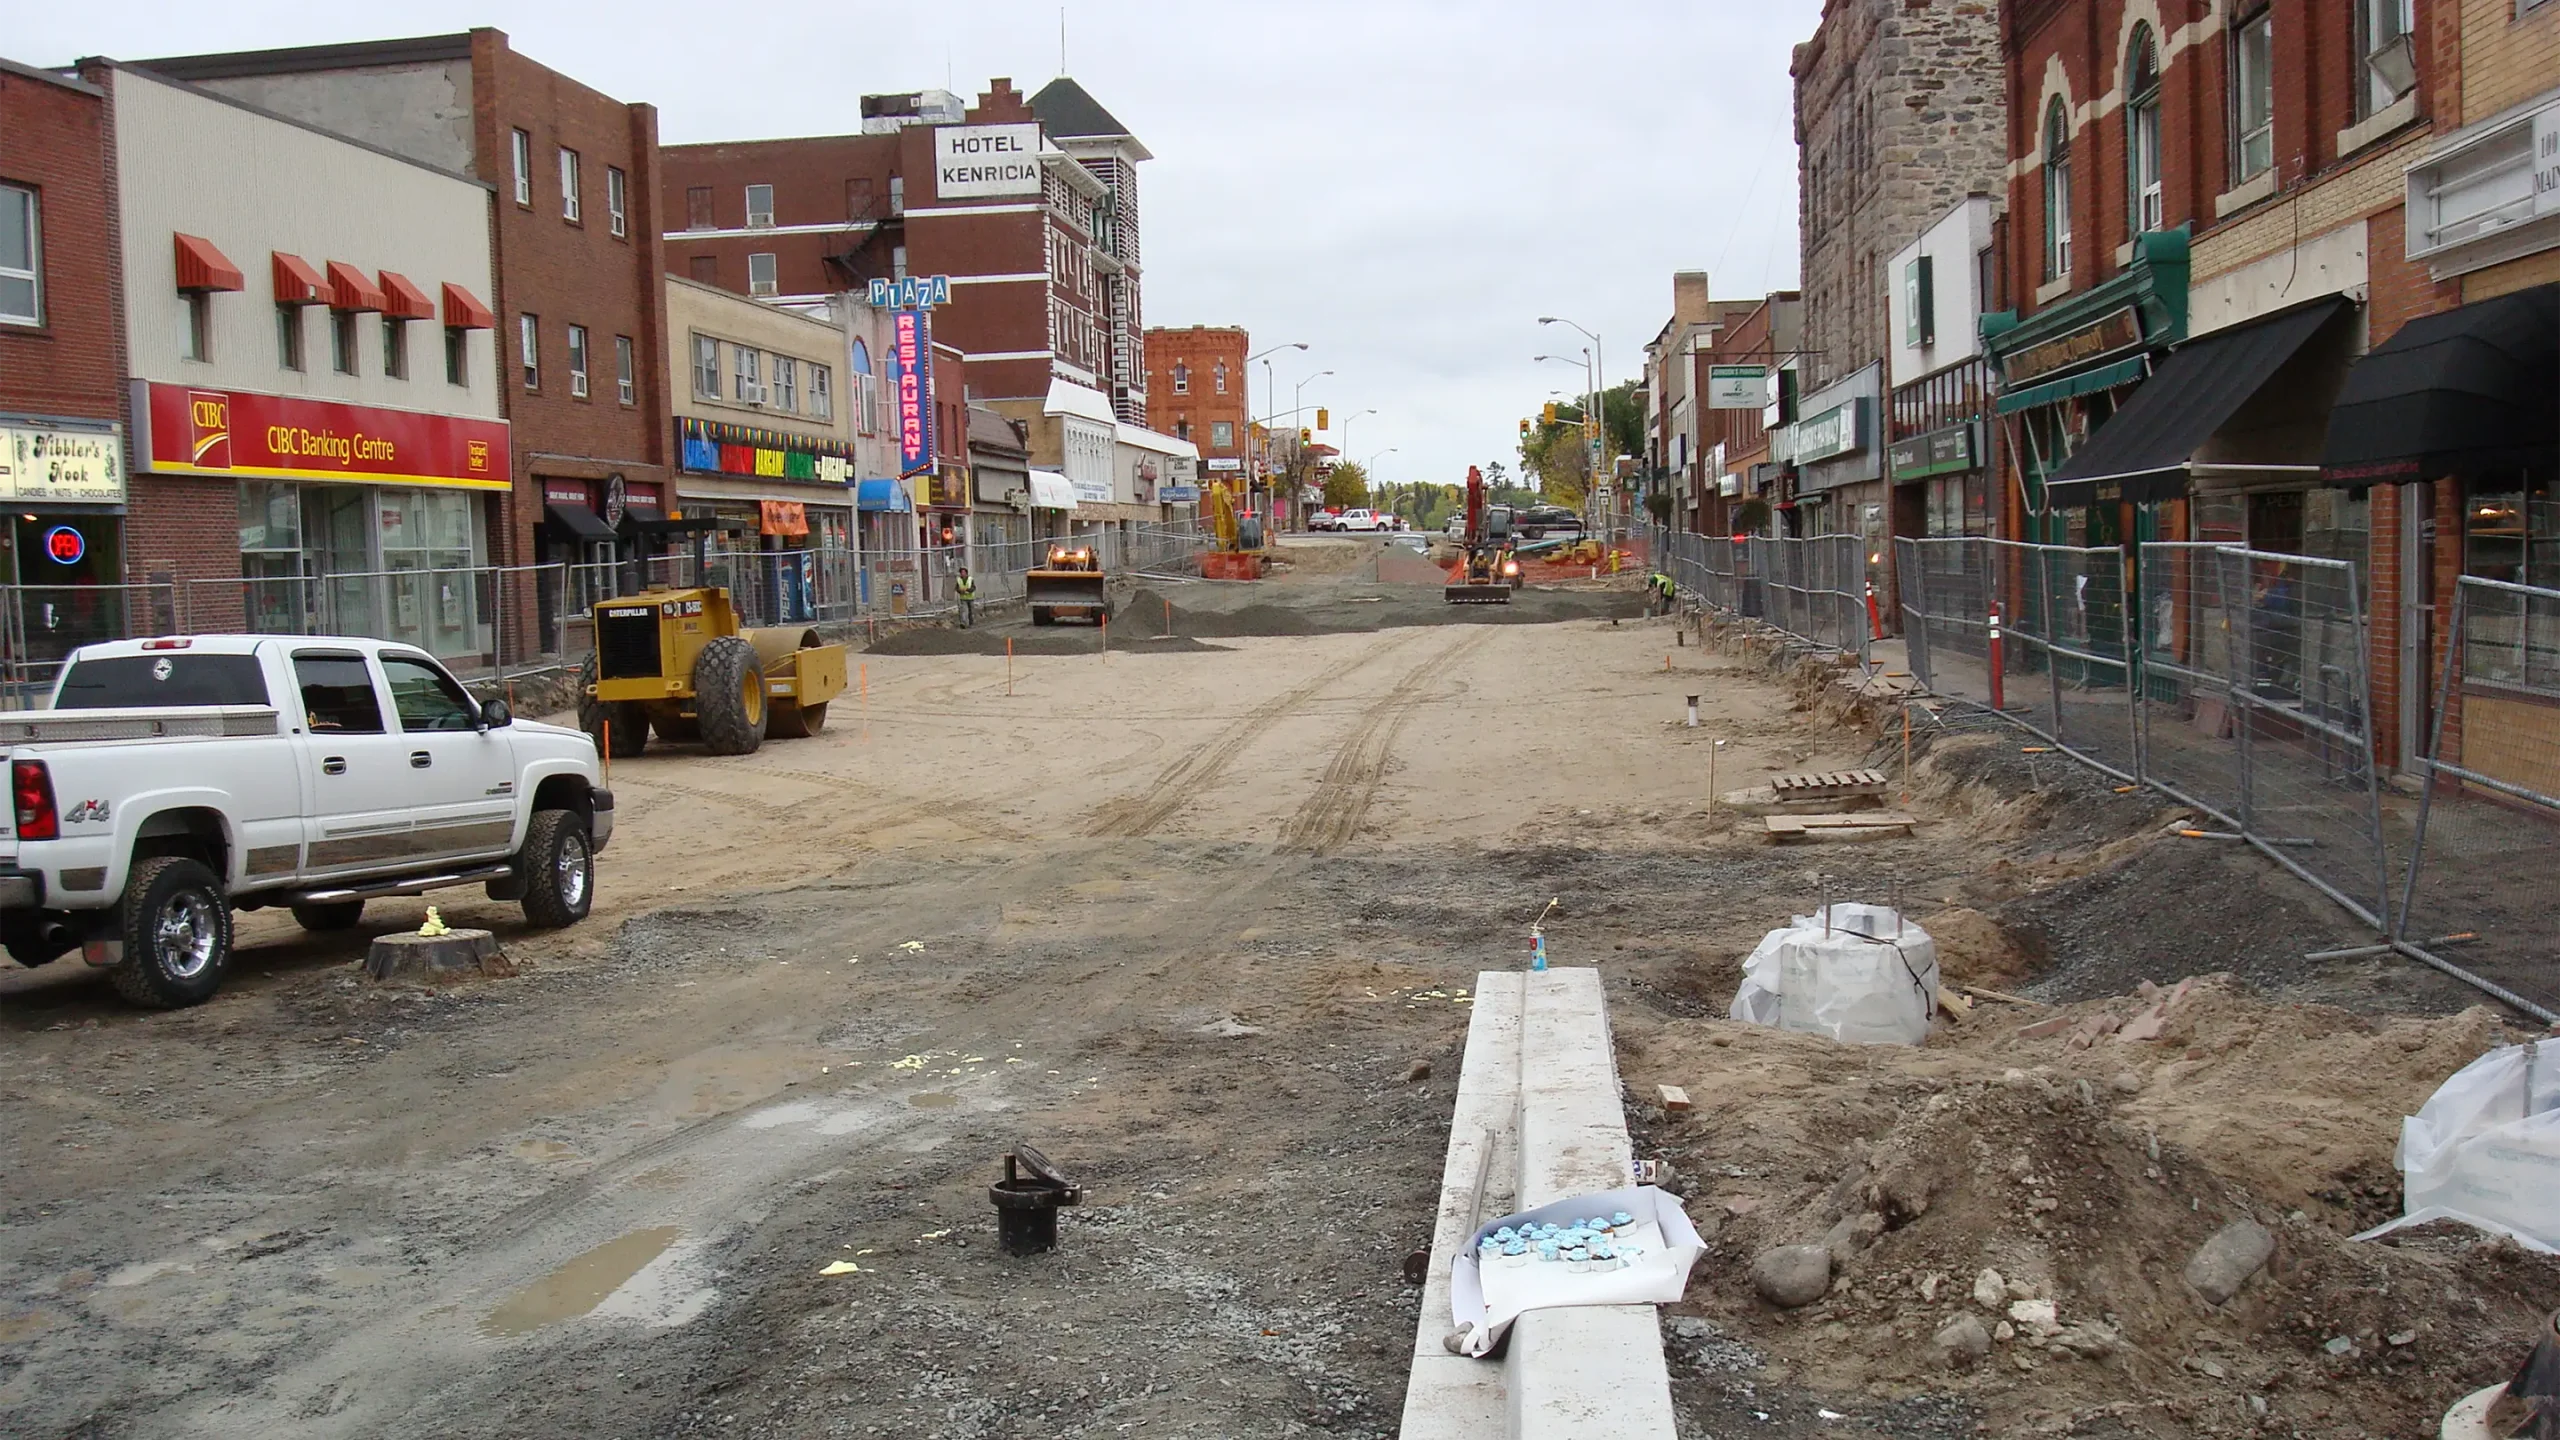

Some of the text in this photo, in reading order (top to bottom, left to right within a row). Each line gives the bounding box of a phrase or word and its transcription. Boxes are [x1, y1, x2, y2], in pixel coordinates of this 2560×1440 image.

[952, 136, 1023, 154] HOTEL
[2541, 131, 2558, 159] 100
[943, 165, 1036, 183] KENRICIA
[873, 279, 945, 308] PLAZA
[897, 314, 921, 461] RESTAURANT
[193, 401, 227, 429] CIBC
[33, 434, 100, 459] Nibbler's
[267, 425, 394, 465] CIBC Banking Centre
[48, 460, 89, 483] Nook
[80, 488, 122, 499] CHOCOLATES
[51, 534, 80, 556] OPEN
[781, 579, 791, 620] PEPSI
[608, 608, 648, 618] CATERPILLAR
